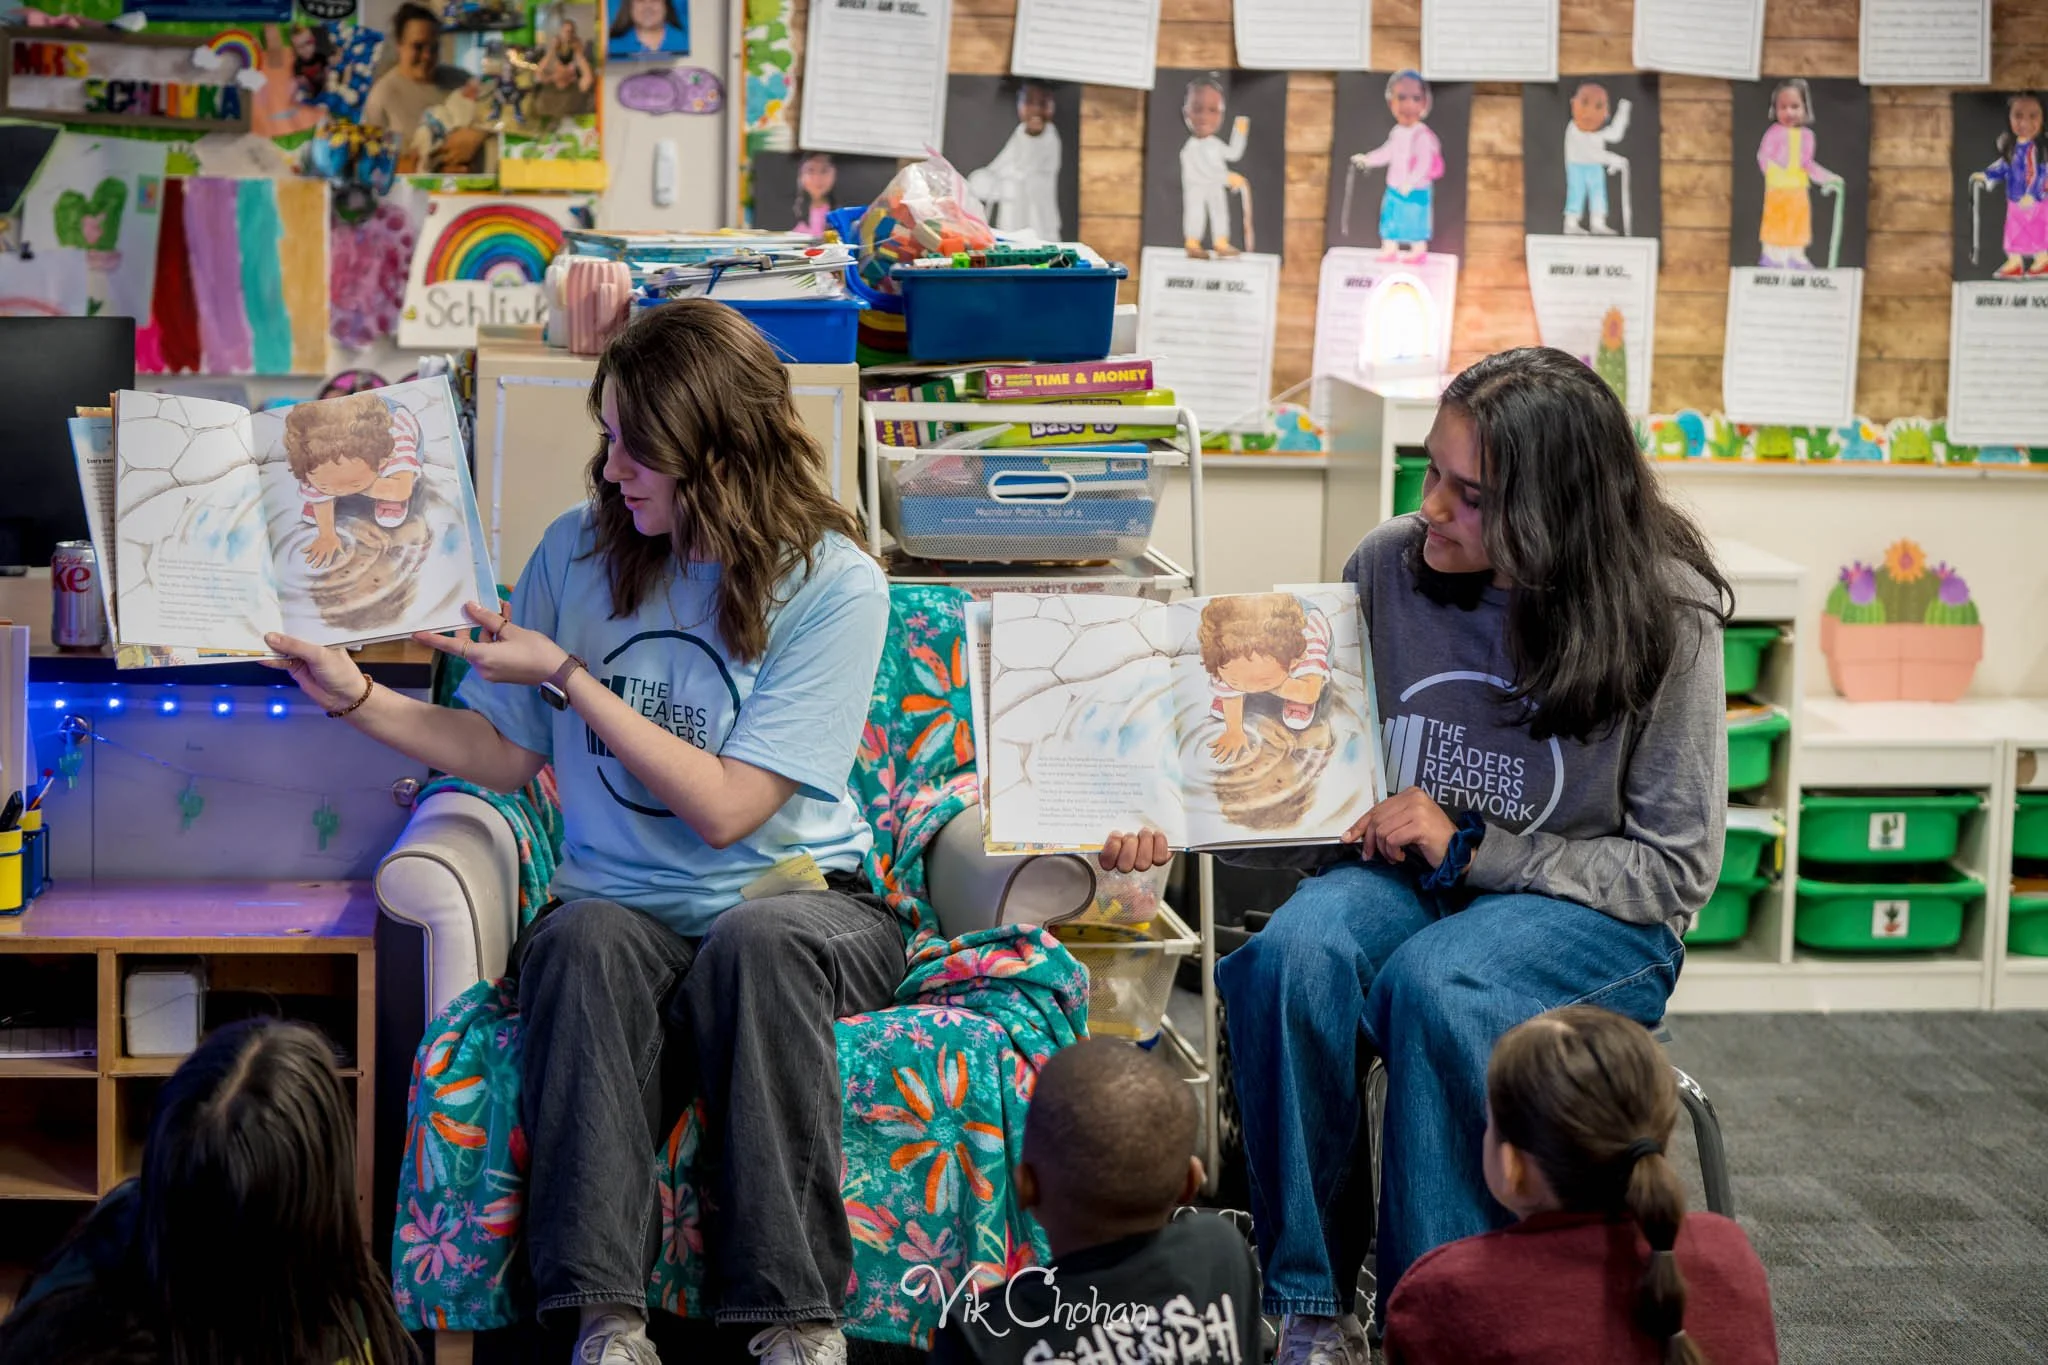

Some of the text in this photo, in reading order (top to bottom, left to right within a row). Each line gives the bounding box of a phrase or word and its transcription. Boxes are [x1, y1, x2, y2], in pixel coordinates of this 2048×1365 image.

[13, 42, 89, 78] MRS
[1034, 374, 1070, 386] TIME
[1075, 372, 1087, 385] &
[1092, 368, 1148, 383] MONEY
[629, 677, 669, 699] THE
[630, 696, 707, 728] EAERS
[1426, 718, 1467, 744] THE
[1426, 737, 1525, 777] LEADERS
[1422, 759, 1523, 800] READERS
[1421, 780, 1536, 821] NETWORK
